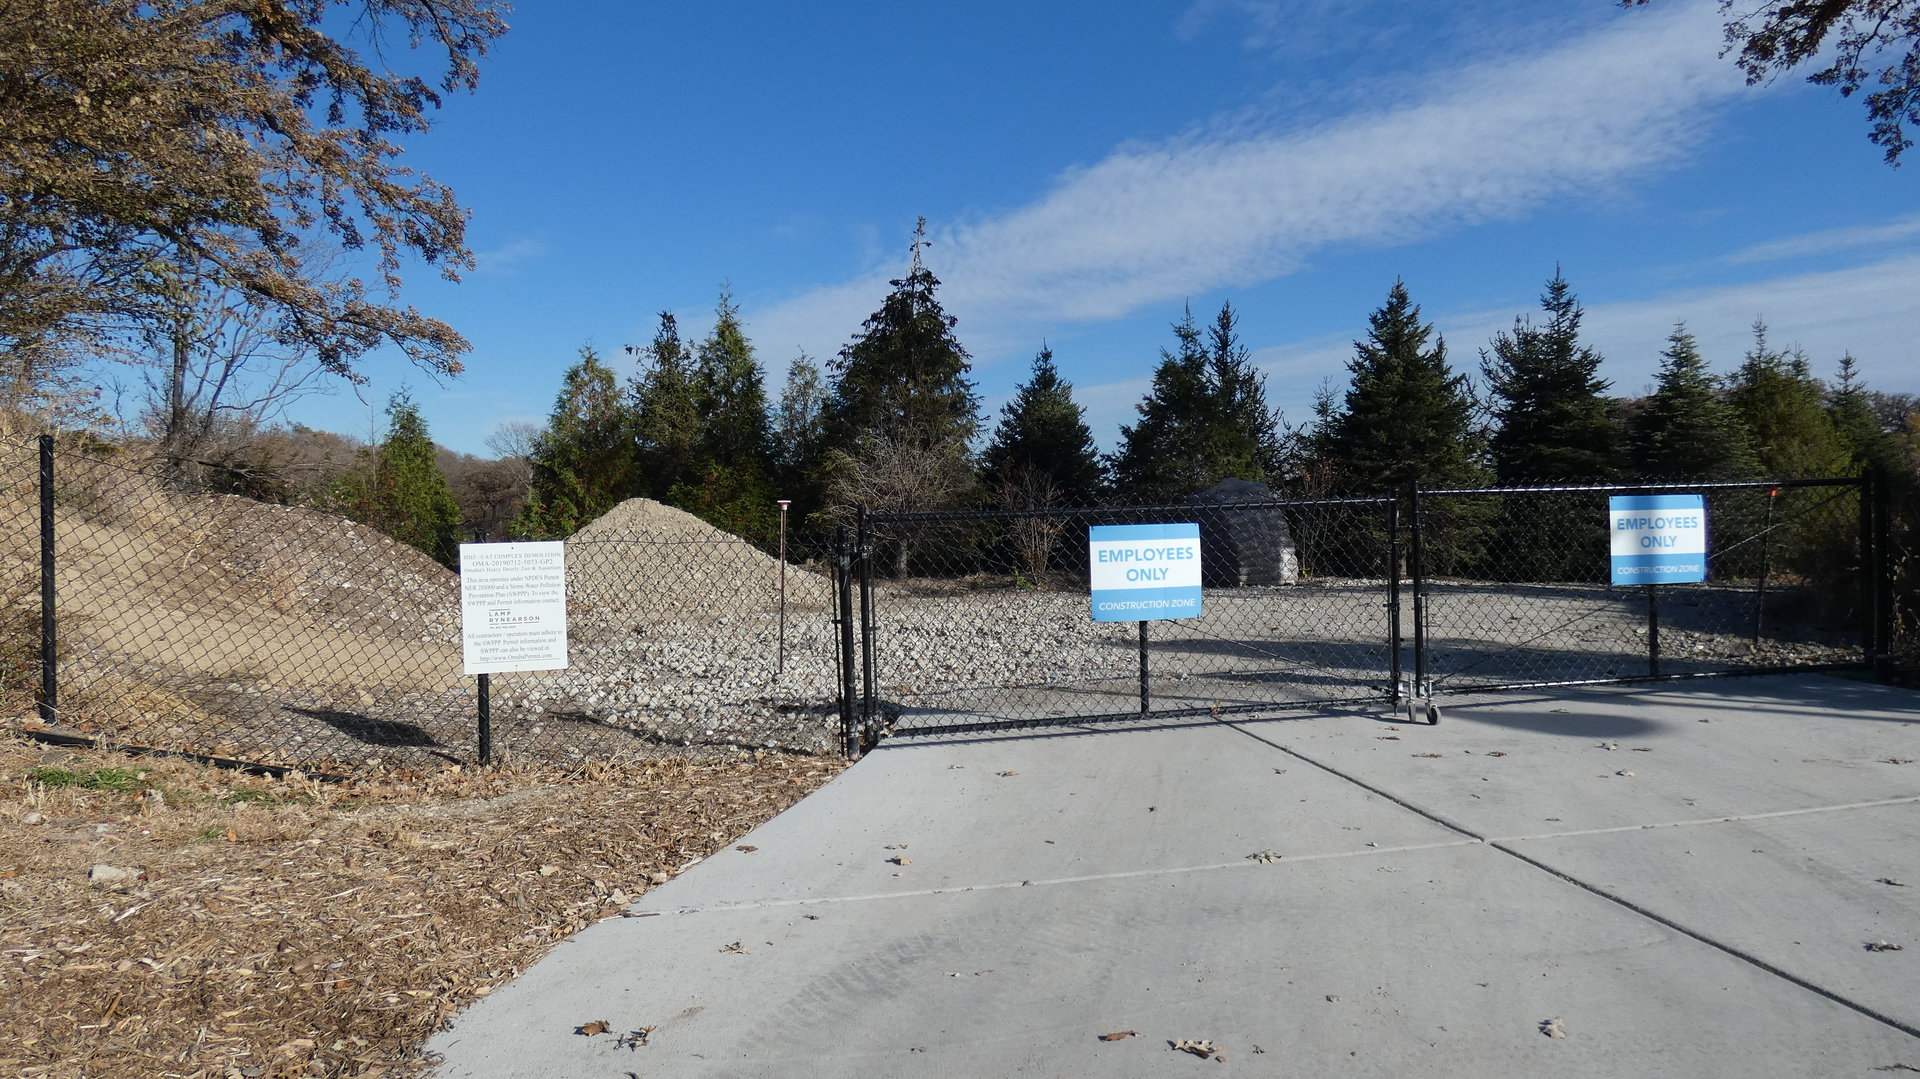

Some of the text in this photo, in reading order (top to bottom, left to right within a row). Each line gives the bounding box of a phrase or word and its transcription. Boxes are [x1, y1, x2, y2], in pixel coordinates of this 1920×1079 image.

[1617, 517, 1698, 530] EMPLOYEES
[1640, 536, 1677, 548] ONLY
[1098, 547, 1193, 562] EMPLOYEES
[1126, 568, 1169, 581] ONLY
[1617, 565, 1700, 574] CONSTRUCTION ZONE
[1099, 599, 1196, 610] CONSTRUCTION ZONE
